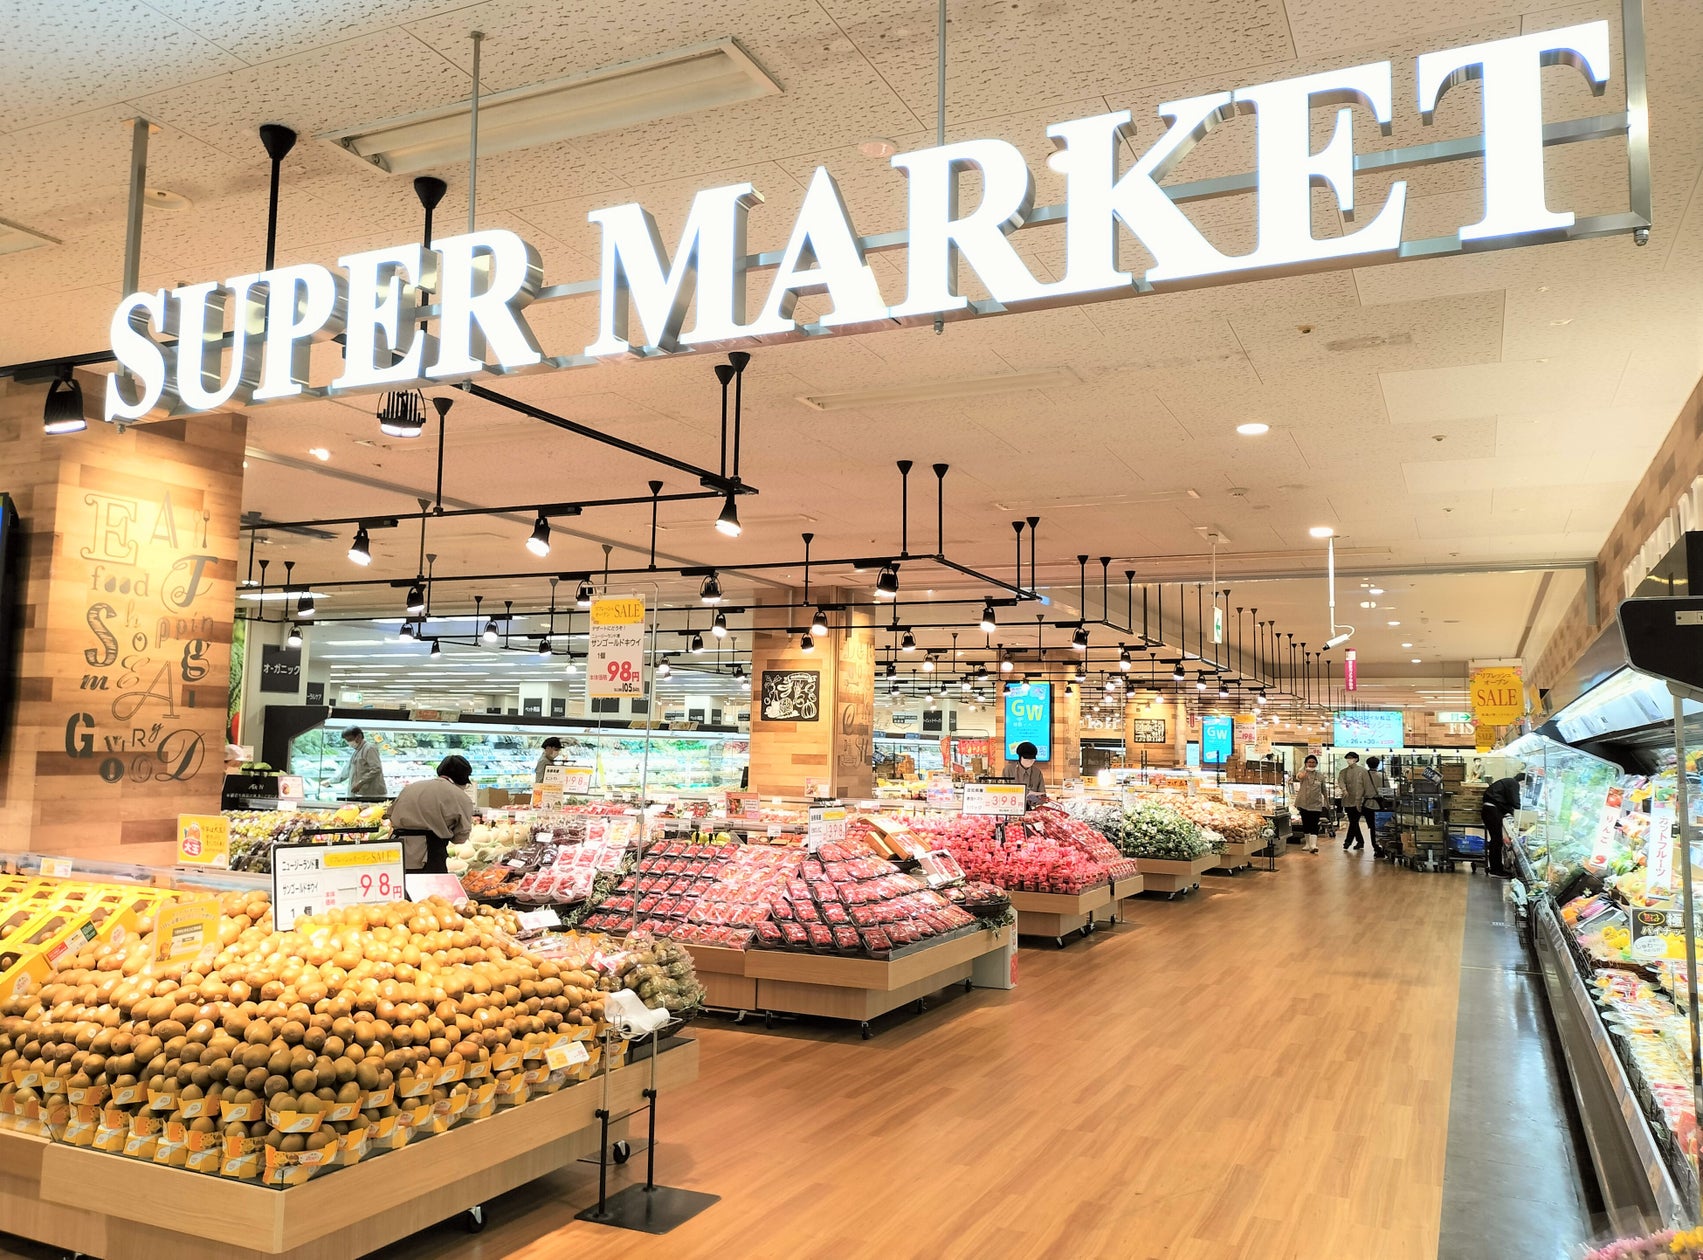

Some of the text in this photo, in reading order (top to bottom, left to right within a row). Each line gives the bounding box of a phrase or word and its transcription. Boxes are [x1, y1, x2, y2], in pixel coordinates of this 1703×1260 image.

[105, 20, 1610, 421] SUPER MARKET
[614, 604, 640, 618] SALE
[591, 638, 641, 647] サンゴールドキウイ
[263, 663, 300, 675] オーガニック
[1477, 688, 1517, 706] SALE
[1011, 699, 1044, 721] GW
[1207, 726, 1227, 740] GW
